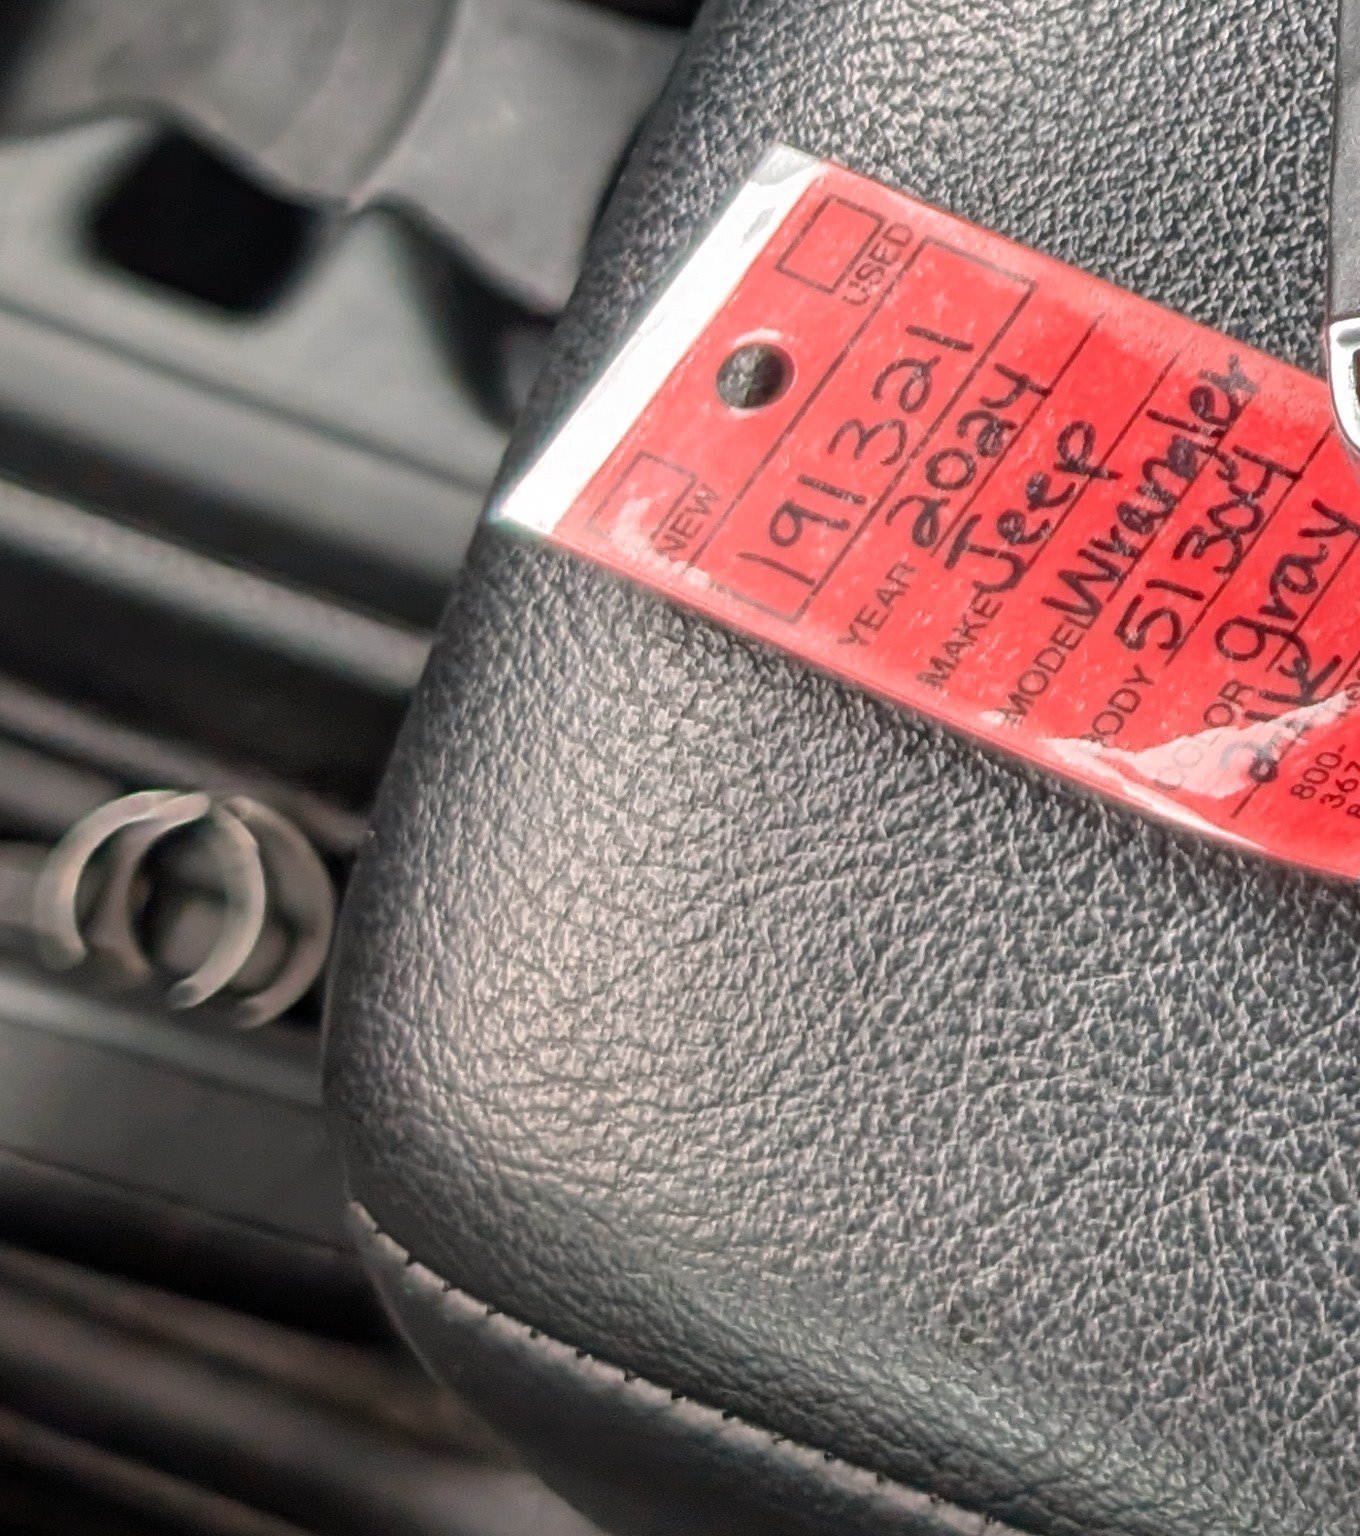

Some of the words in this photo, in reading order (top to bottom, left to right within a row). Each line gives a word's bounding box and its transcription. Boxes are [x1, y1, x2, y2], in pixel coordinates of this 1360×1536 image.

[842, 221, 914, 307] USED
[655, 482, 721, 565] NEW
[737, 325, 974, 587] 191321
[838, 562, 922, 648] YEAR
[886, 361, 1053, 550] 2024
[944, 420, 1122, 600] Jeep
[1041, 352, 1261, 618] Wrangler
[1114, 445, 1303, 651] 51304
[916, 590, 1004, 692] MAKE
[1000, 606, 1100, 727] MODEL
[1290, 744, 1347, 801] 800-
